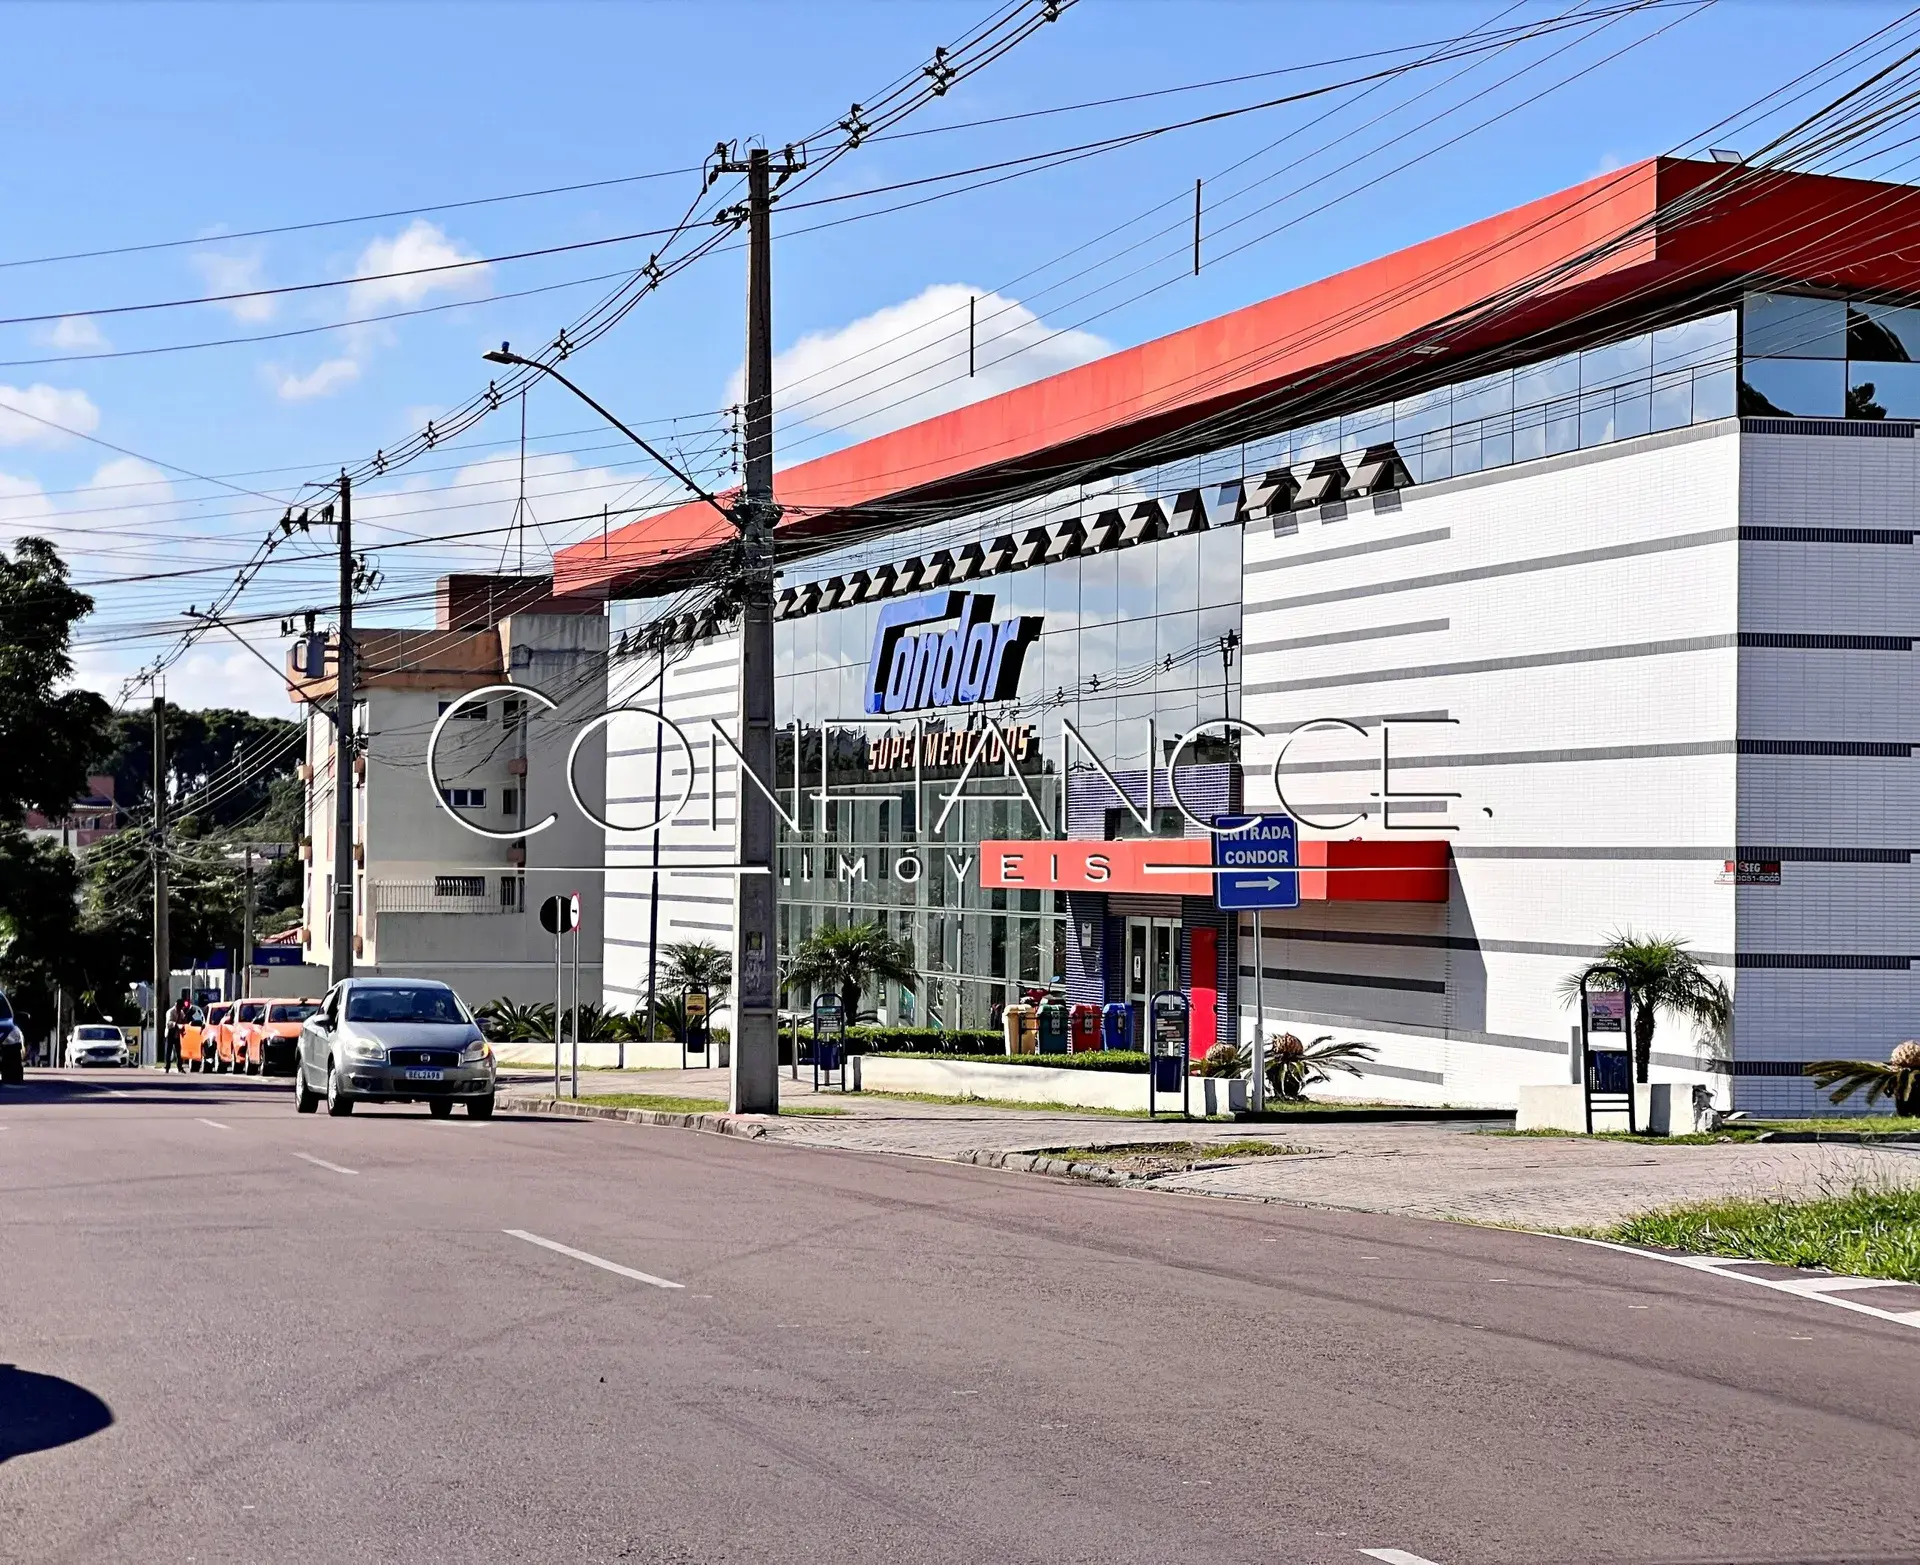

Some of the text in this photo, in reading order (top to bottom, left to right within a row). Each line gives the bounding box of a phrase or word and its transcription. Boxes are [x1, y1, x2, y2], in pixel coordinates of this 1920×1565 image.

[864, 590, 1044, 714] Condor
[1220, 826, 1291, 841] ENTRADA
[1225, 850, 1289, 864] CONDOR
